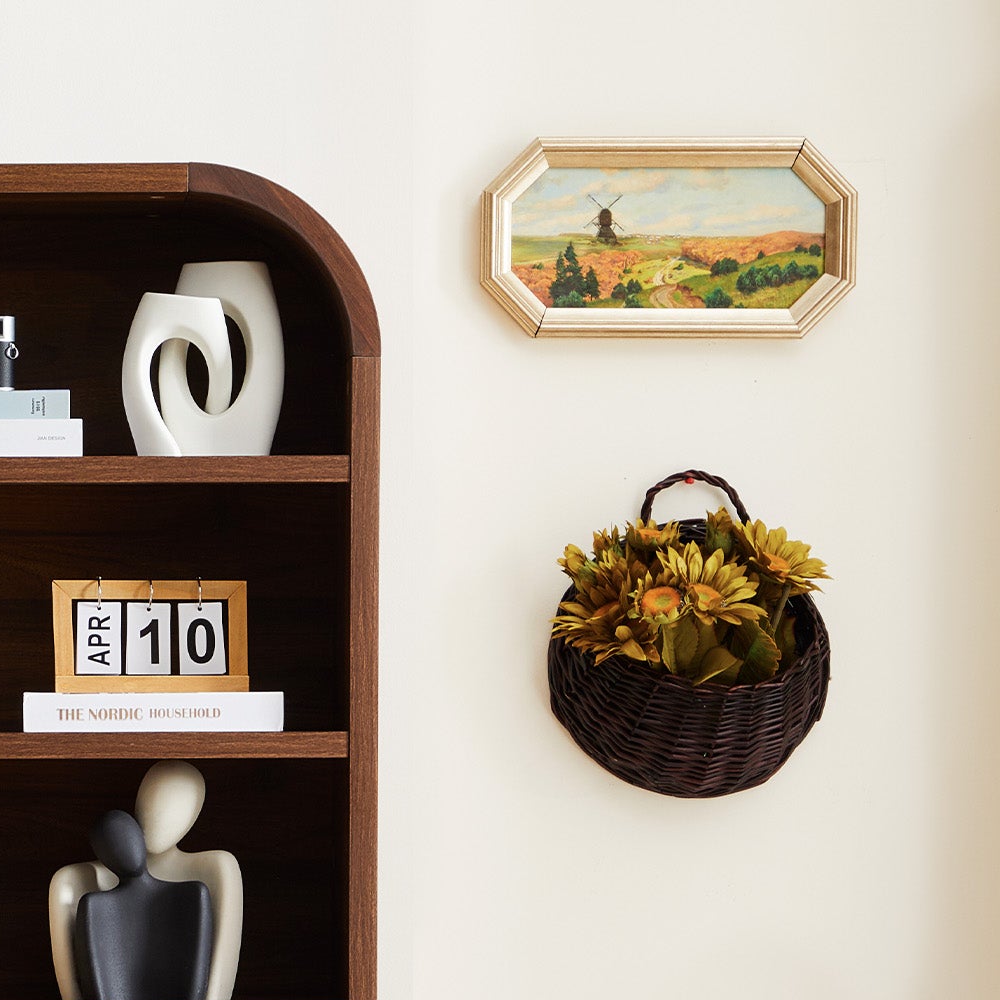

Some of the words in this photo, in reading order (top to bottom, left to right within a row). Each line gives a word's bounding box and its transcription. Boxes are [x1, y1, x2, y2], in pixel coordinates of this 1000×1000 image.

[87, 615, 111, 666] APR
[56, 708, 84, 722] THE
[88, 707, 143, 721] NORDIC
[149, 707, 221, 719] HOUSEHOLD
